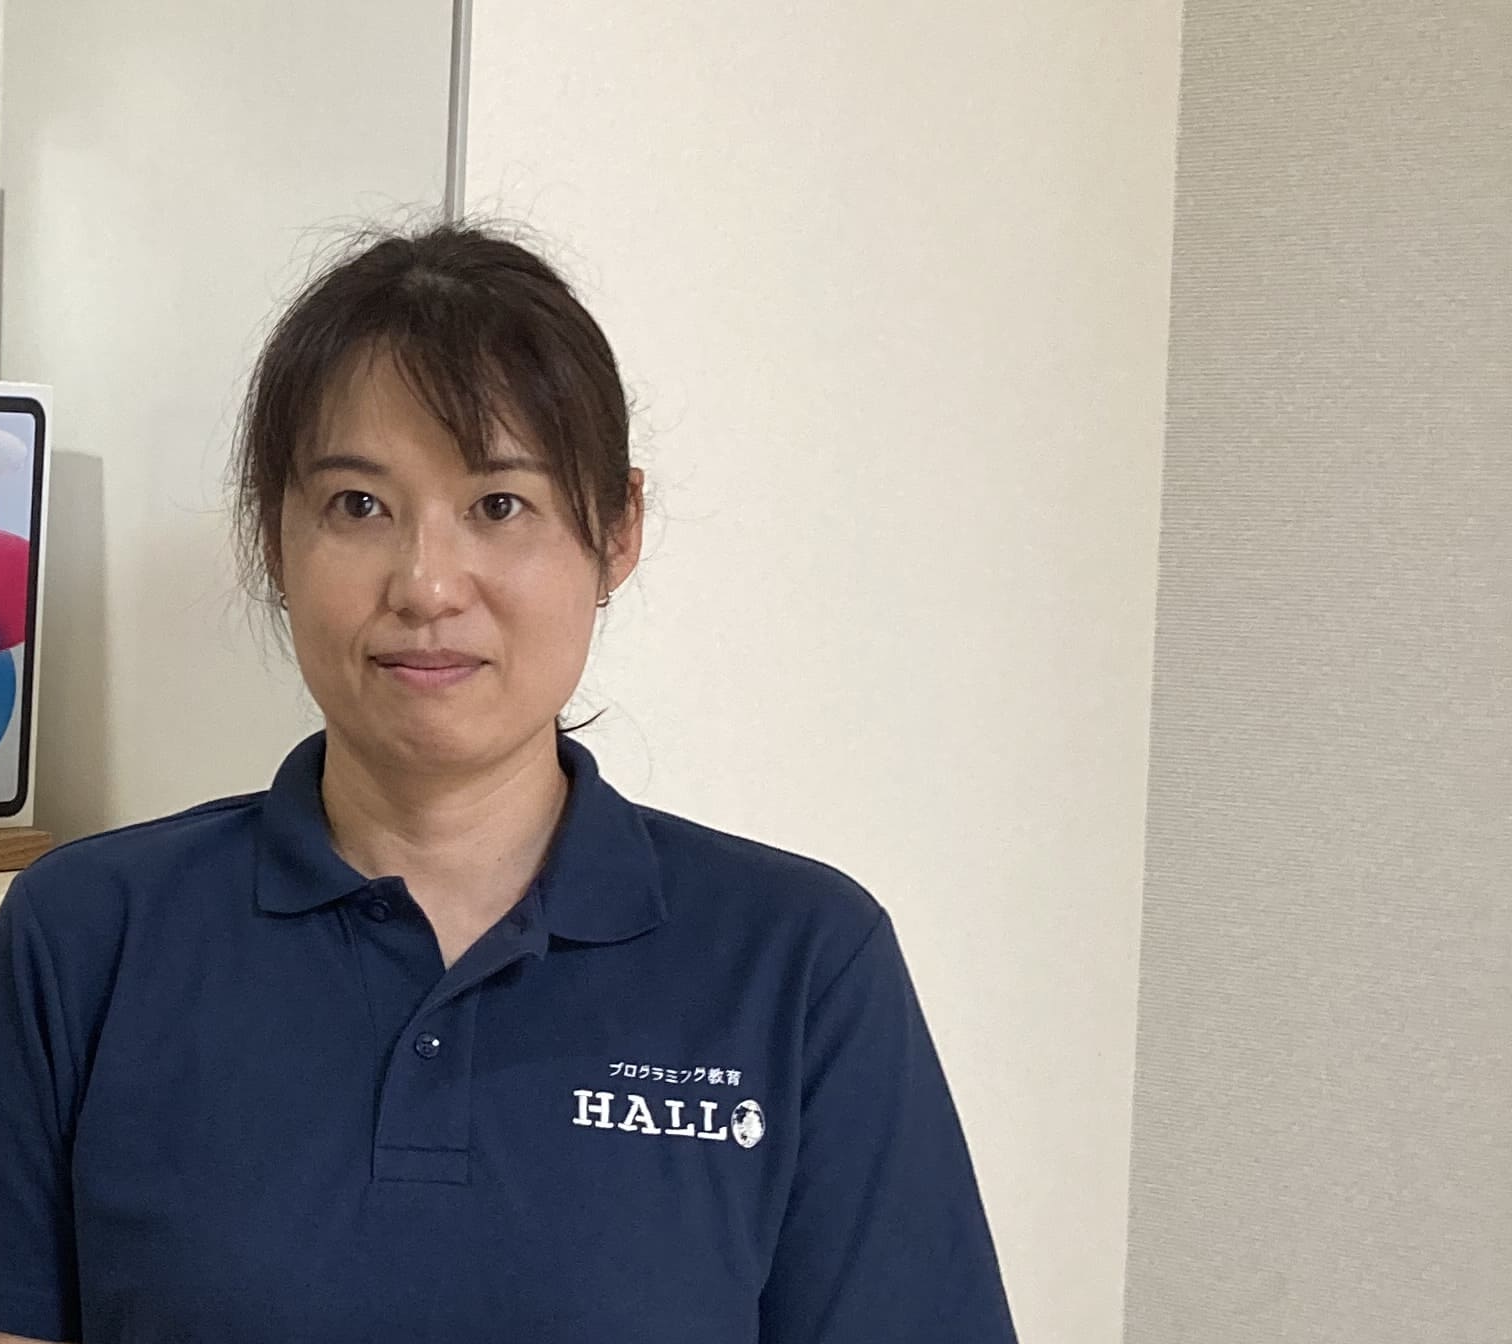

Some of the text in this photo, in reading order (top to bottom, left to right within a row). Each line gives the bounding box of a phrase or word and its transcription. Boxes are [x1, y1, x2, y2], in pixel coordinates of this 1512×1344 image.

[609, 1061, 742, 1086] プログラミング教育
